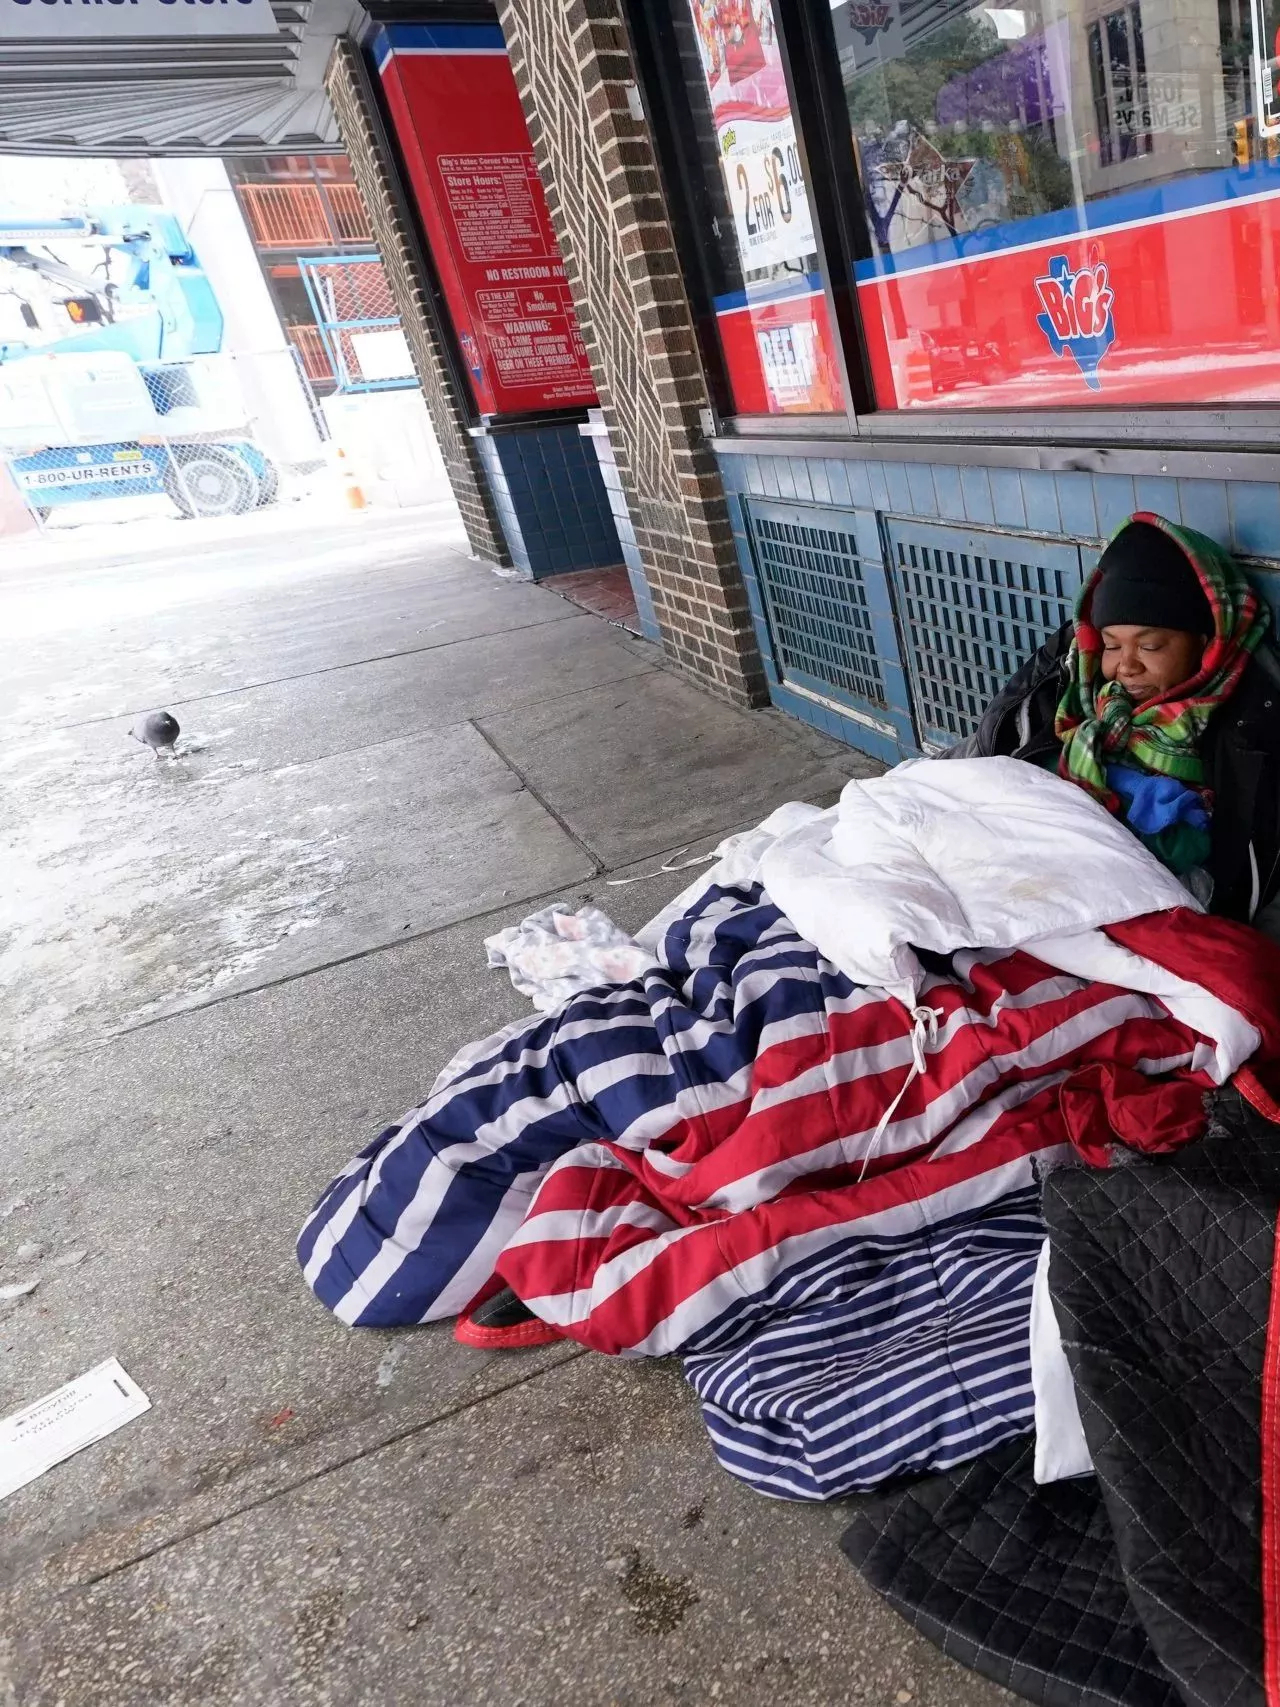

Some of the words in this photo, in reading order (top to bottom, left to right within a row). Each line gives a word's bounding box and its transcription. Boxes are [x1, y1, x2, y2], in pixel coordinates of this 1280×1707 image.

[447, 176, 472, 186] Store
[473, 175, 503, 186] Hours:
[736, 163, 758, 236] 2
[752, 192, 775, 234] FOR
[485, 269, 500, 281] NO
[501, 266, 551, 280] RESTROOM
[479, 292, 490, 300] IT'S
[490, 292, 502, 300] THE
[502, 291, 515, 299] LAW
[533, 290, 544, 301] No
[526, 301, 557, 312] Smoking
[503, 319, 552, 335] WARNING:
[506, 336, 512, 347] A
[511, 334, 533, 346] CRIME
[493, 348, 504, 359] TO
[503, 345, 534, 358] CONSUME
[534, 343, 558, 356] LIQUOR
[557, 343, 568, 354] OR
[497, 359, 515, 370] BEER
[514, 358, 524, 369] ON
[523, 356, 544, 368] THESE
[544, 353, 577, 366] PREMISES.
[24, 462, 152, 485] 1-800-UR-RENTS
